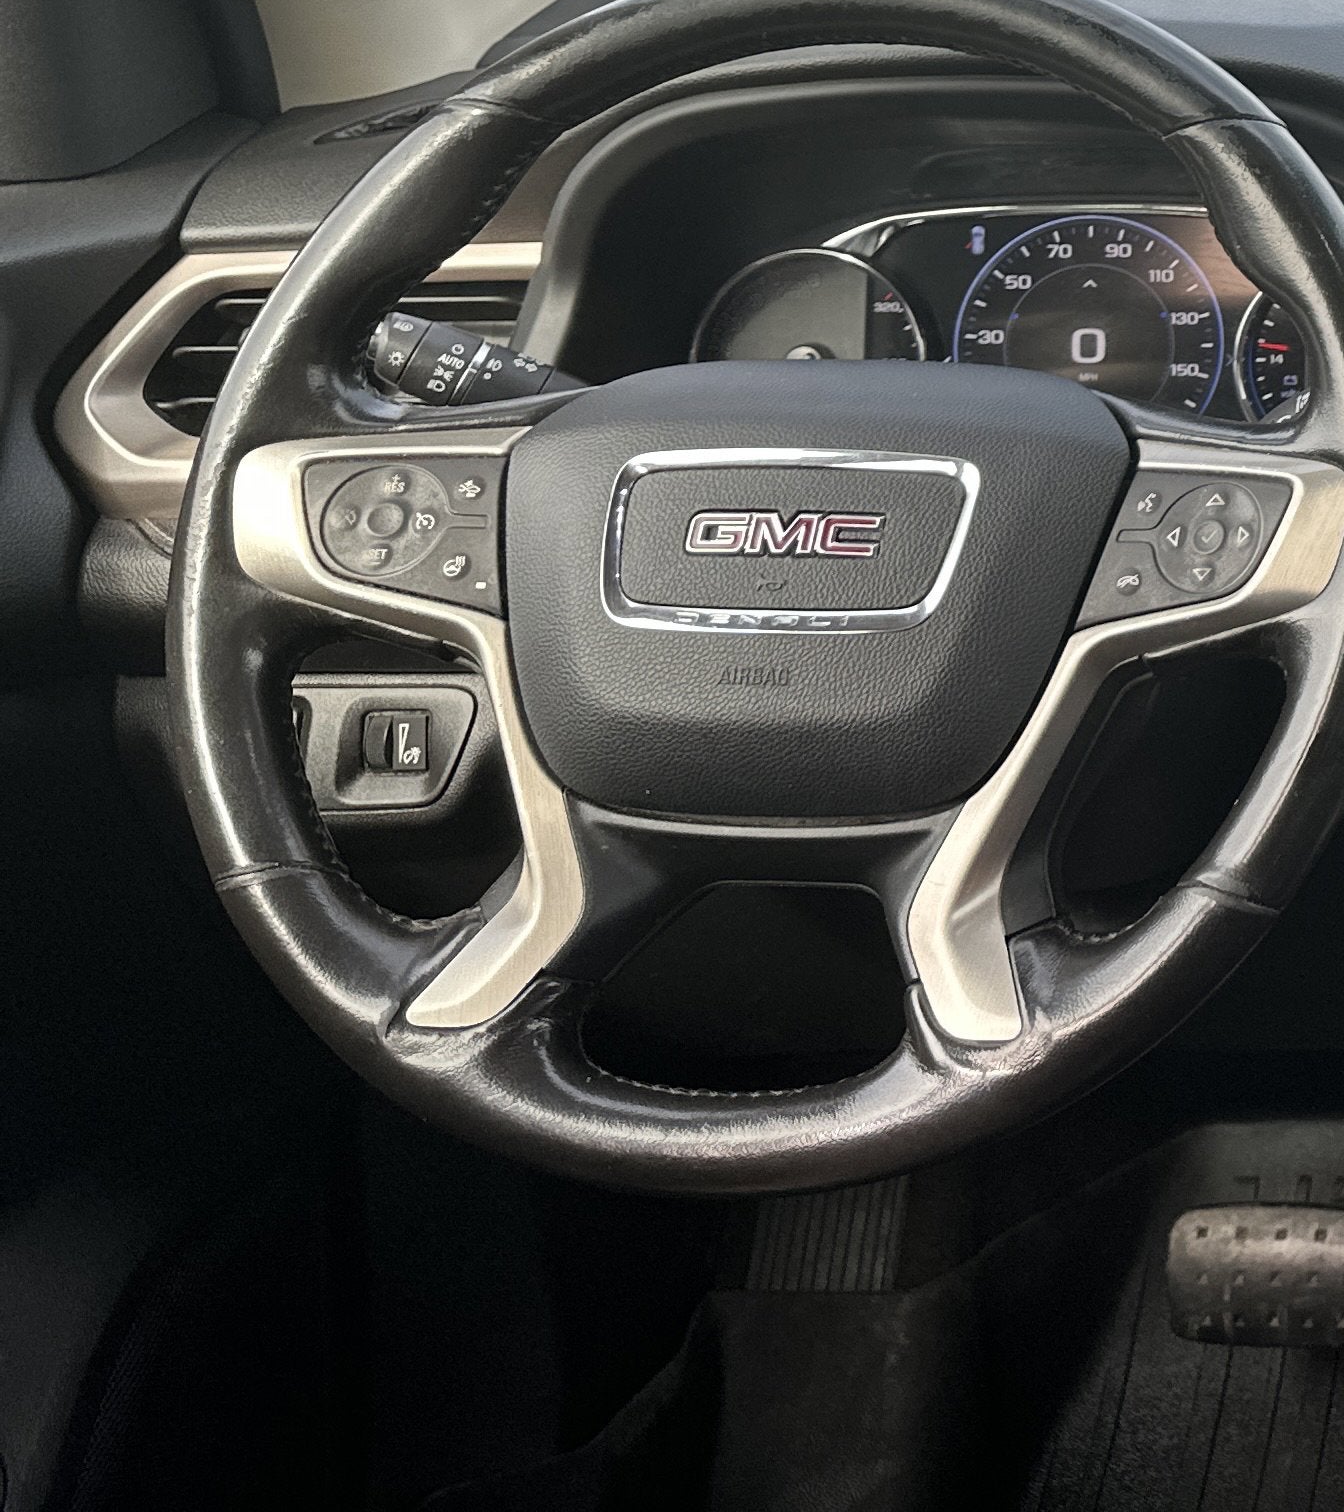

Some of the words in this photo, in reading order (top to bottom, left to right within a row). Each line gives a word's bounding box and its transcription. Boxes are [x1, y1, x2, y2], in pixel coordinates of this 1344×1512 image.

[1046, 243, 1073, 259] 70
[1104, 243, 1133, 259] 90
[1004, 274, 1032, 290] 50
[1148, 268, 1175, 284] 110
[1169, 311, 1199, 326] 130
[977, 329, 1005, 345] 30
[1071, 327, 1106, 364] 0
[436, 353, 465, 370] AUTO
[1269, 354, 1285, 365] 14
[1169, 363, 1199, 378] 150
[385, 481, 406, 494] RES
[685, 511, 887, 559] GMC
[673, 610, 849, 627] DENALI
